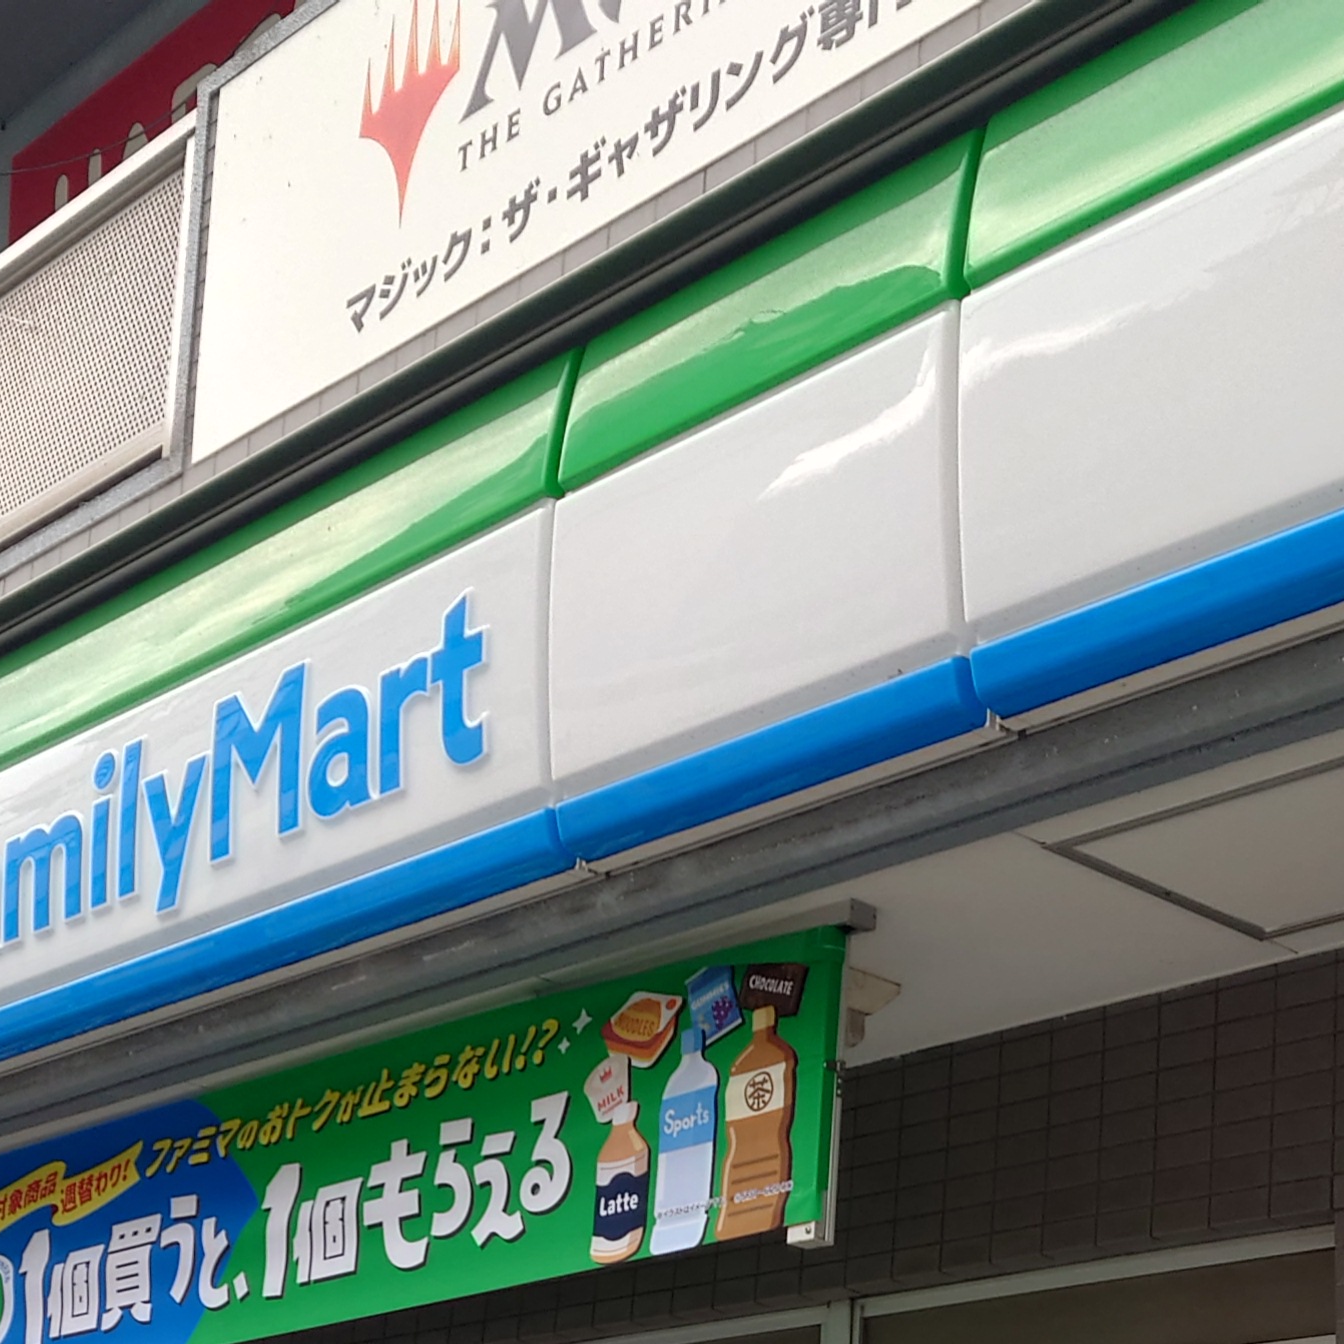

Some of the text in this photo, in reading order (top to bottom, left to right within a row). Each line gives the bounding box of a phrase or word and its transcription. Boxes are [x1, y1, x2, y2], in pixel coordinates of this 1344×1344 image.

[458, 109, 522, 173] THE
[543, 0, 726, 116] GATHER
[749, 974, 794, 996] CHOCOLATE
[616, 1016, 655, 1038] NOODLES
[597, 1086, 625, 1112] MILK
[664, 1101, 710, 1139] Sports
[599, 1190, 639, 1216] Latte
